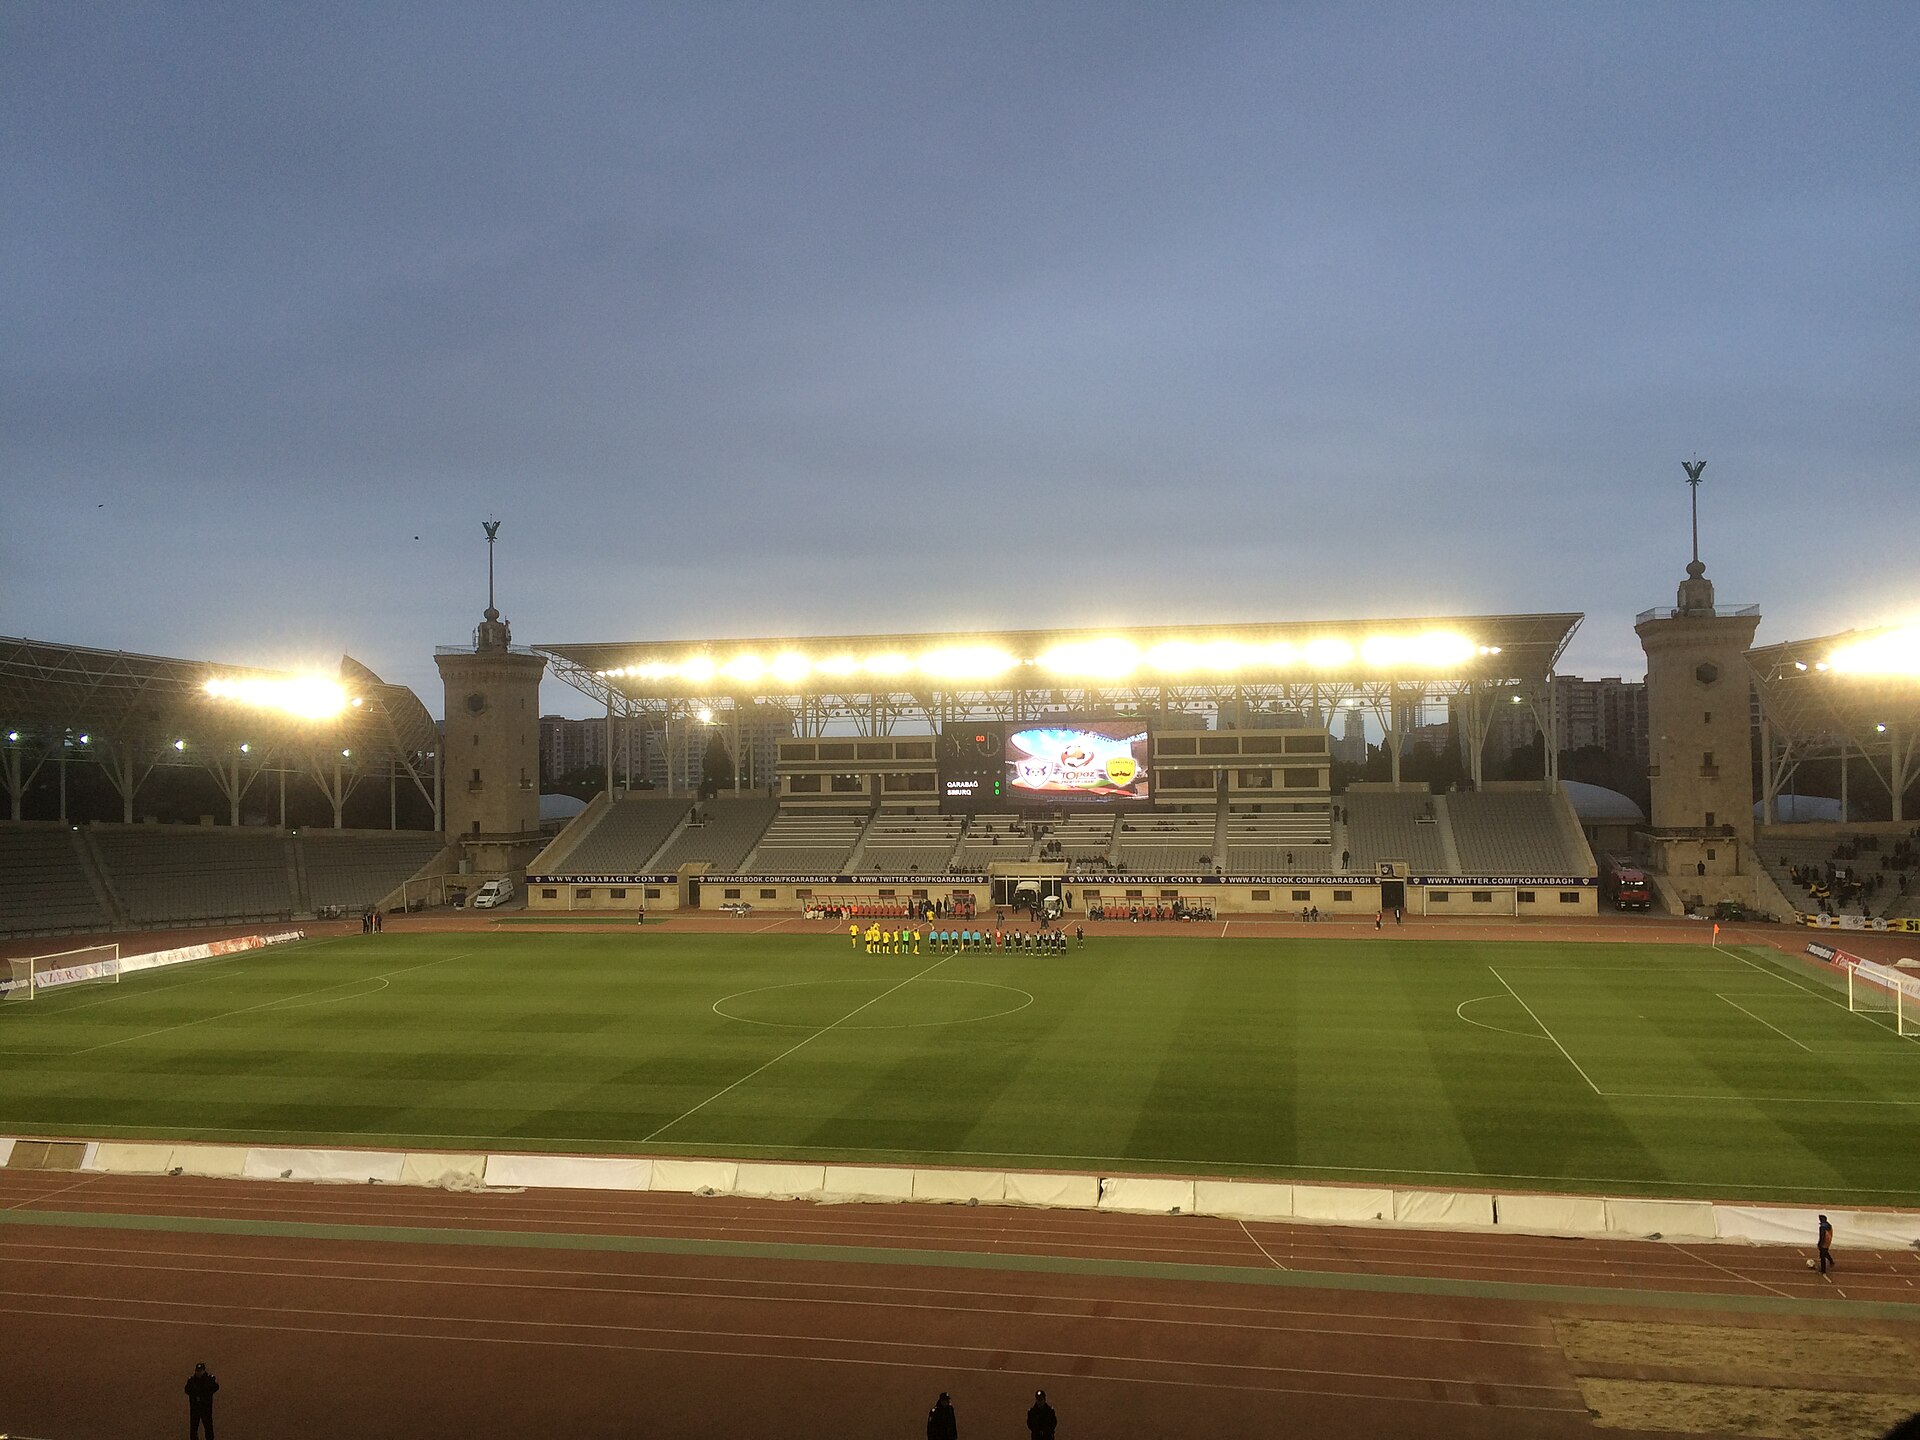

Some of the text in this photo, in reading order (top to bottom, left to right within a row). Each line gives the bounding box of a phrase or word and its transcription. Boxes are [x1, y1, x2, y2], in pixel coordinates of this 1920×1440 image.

[859, 876, 976, 884] WWW.TWITTER.COM/FKQARABAGH
[1228, 877, 1372, 885] WWW.FACEBOOK.COM/FKQARABAGH
[1426, 877, 1575, 885] WWW.TWITTER.COM/FKQARABAGH
